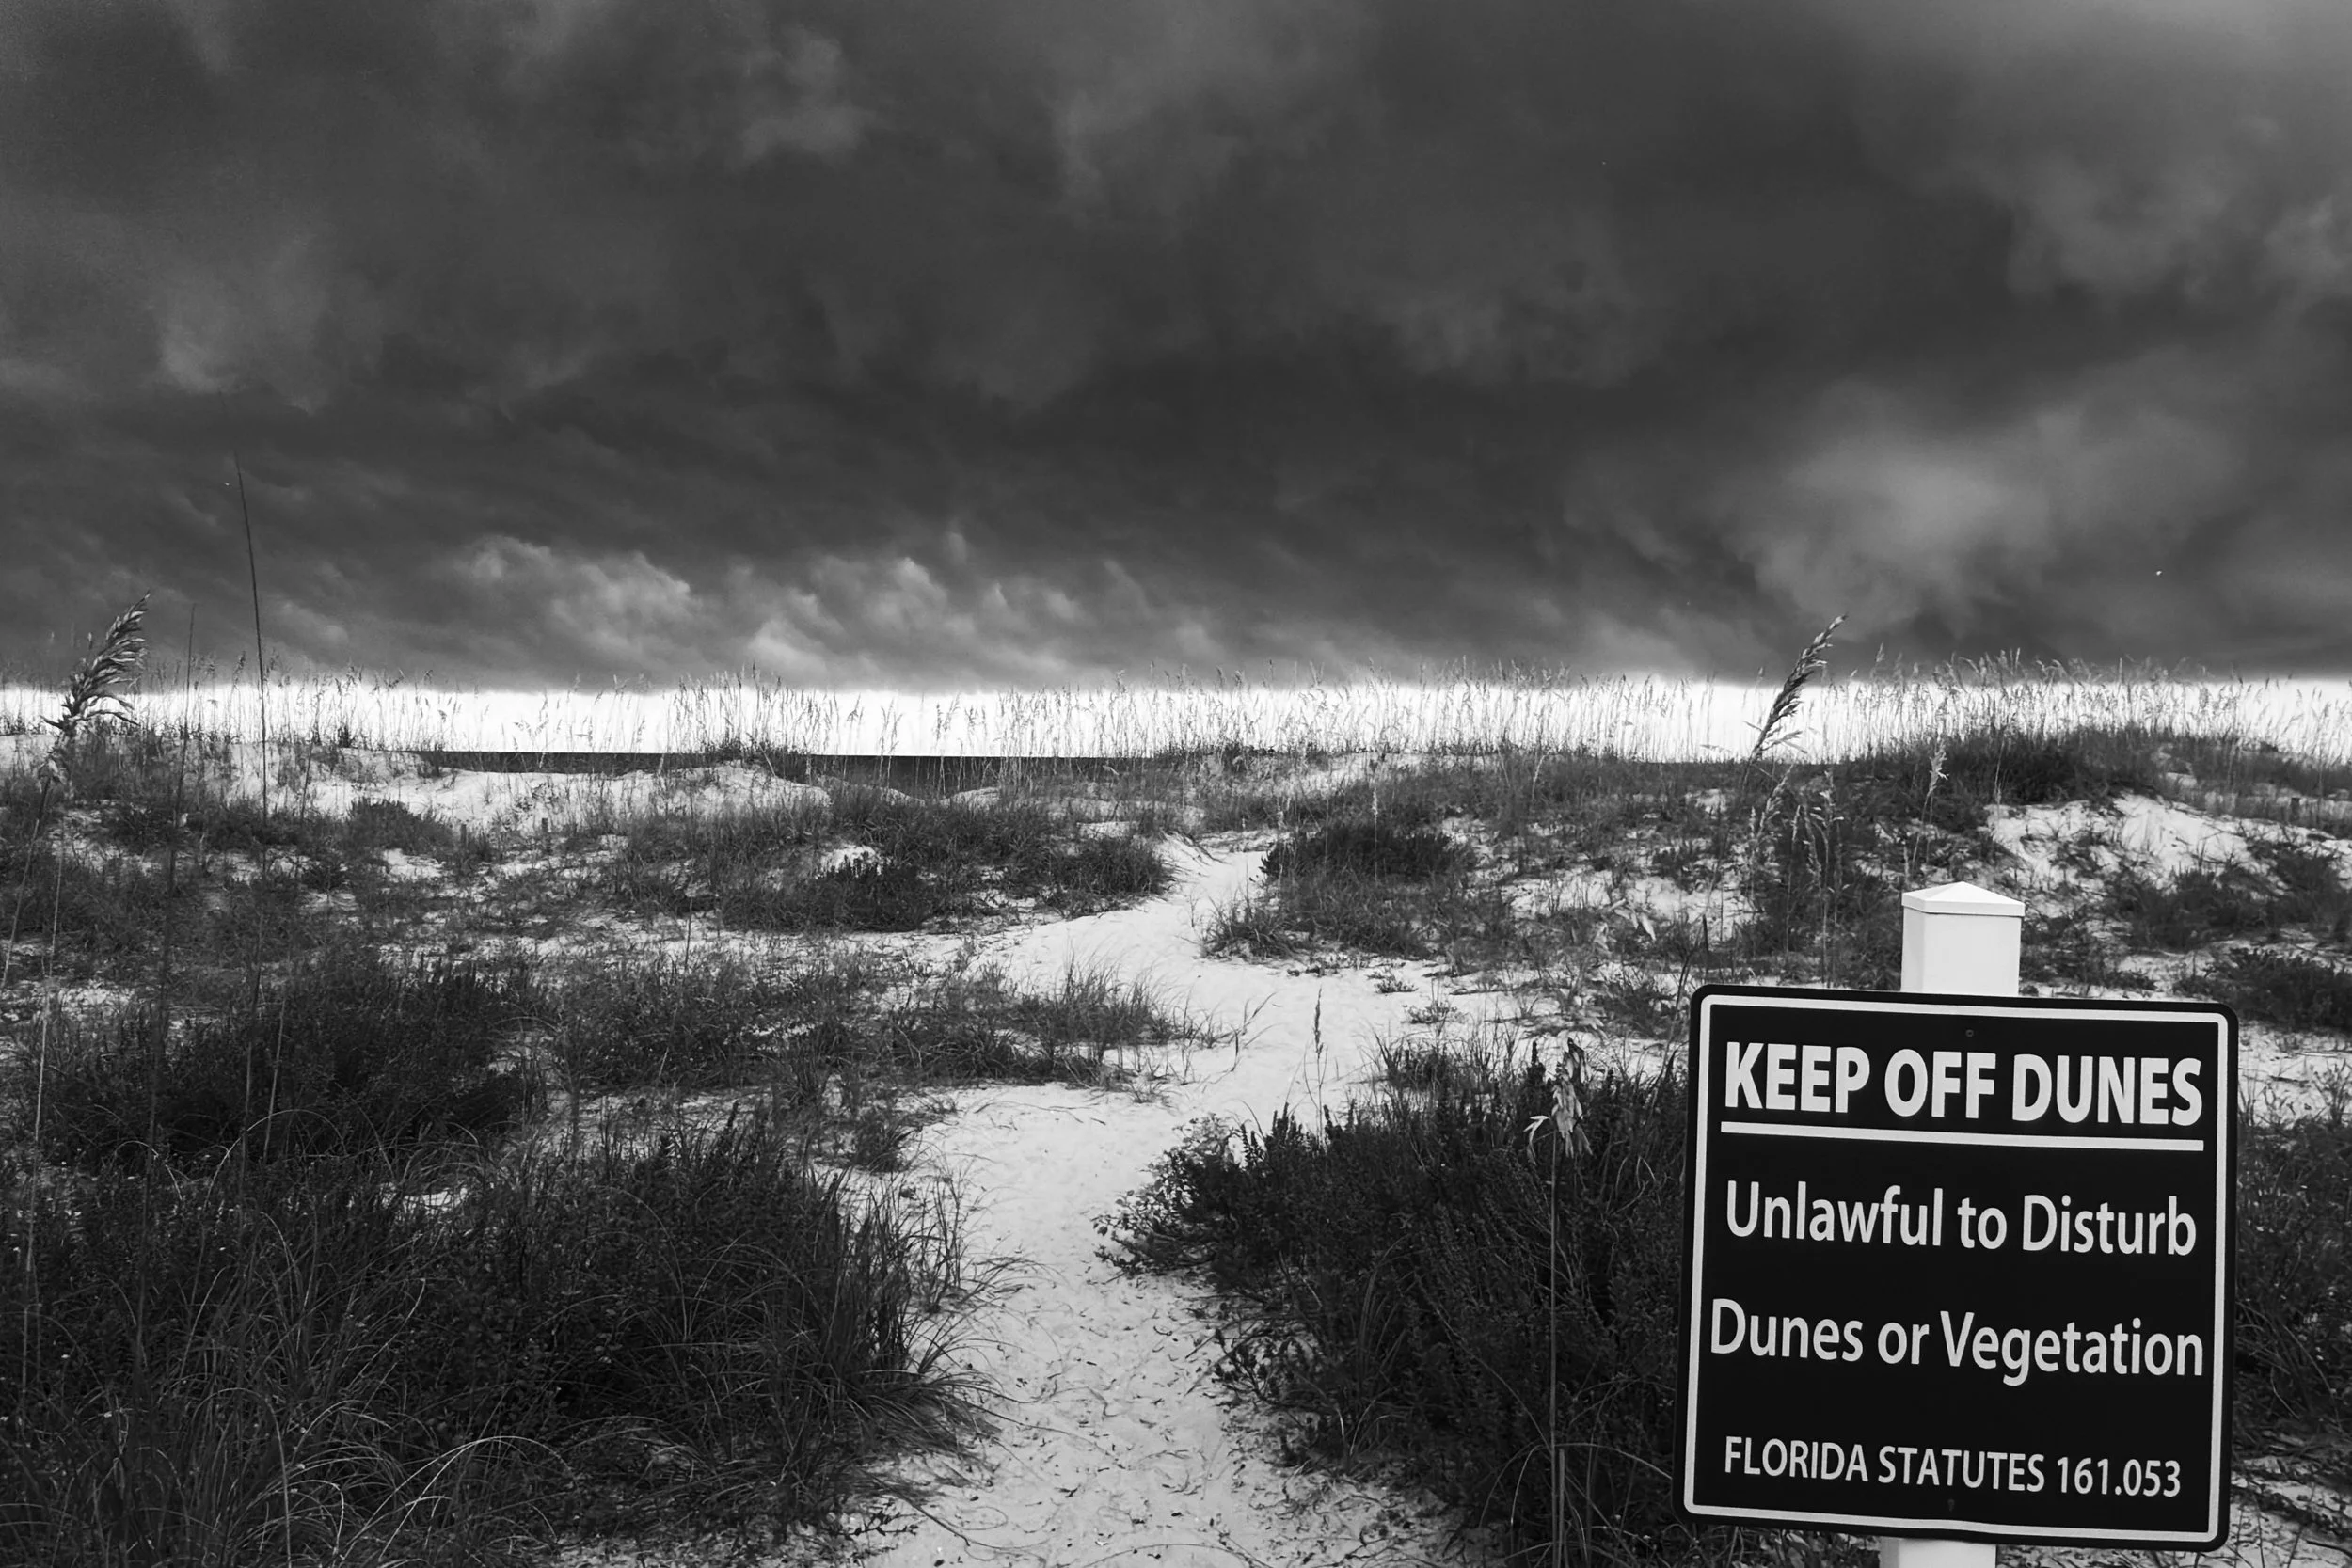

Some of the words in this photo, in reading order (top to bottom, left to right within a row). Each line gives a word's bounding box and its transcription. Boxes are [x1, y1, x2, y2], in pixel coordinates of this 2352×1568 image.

[1724, 1041, 1870, 1114] KEEP
[1884, 1048, 1996, 1119] OFF
[2011, 1053, 2203, 1127] DUNES
[1726, 1180, 1944, 1246] Unlawful
[1957, 1197, 2008, 1250] to
[2022, 1194, 2197, 1256] Disturb
[1710, 1298, 1864, 1362] Dunes
[1877, 1322, 1930, 1365] or
[1940, 1310, 2203, 1386] Vegetation
[1724, 1435, 1868, 1482] FLORIDA
[1878, 1445, 2045, 1493] STATUTES
[2057, 1456, 2181, 1497] 161.053
